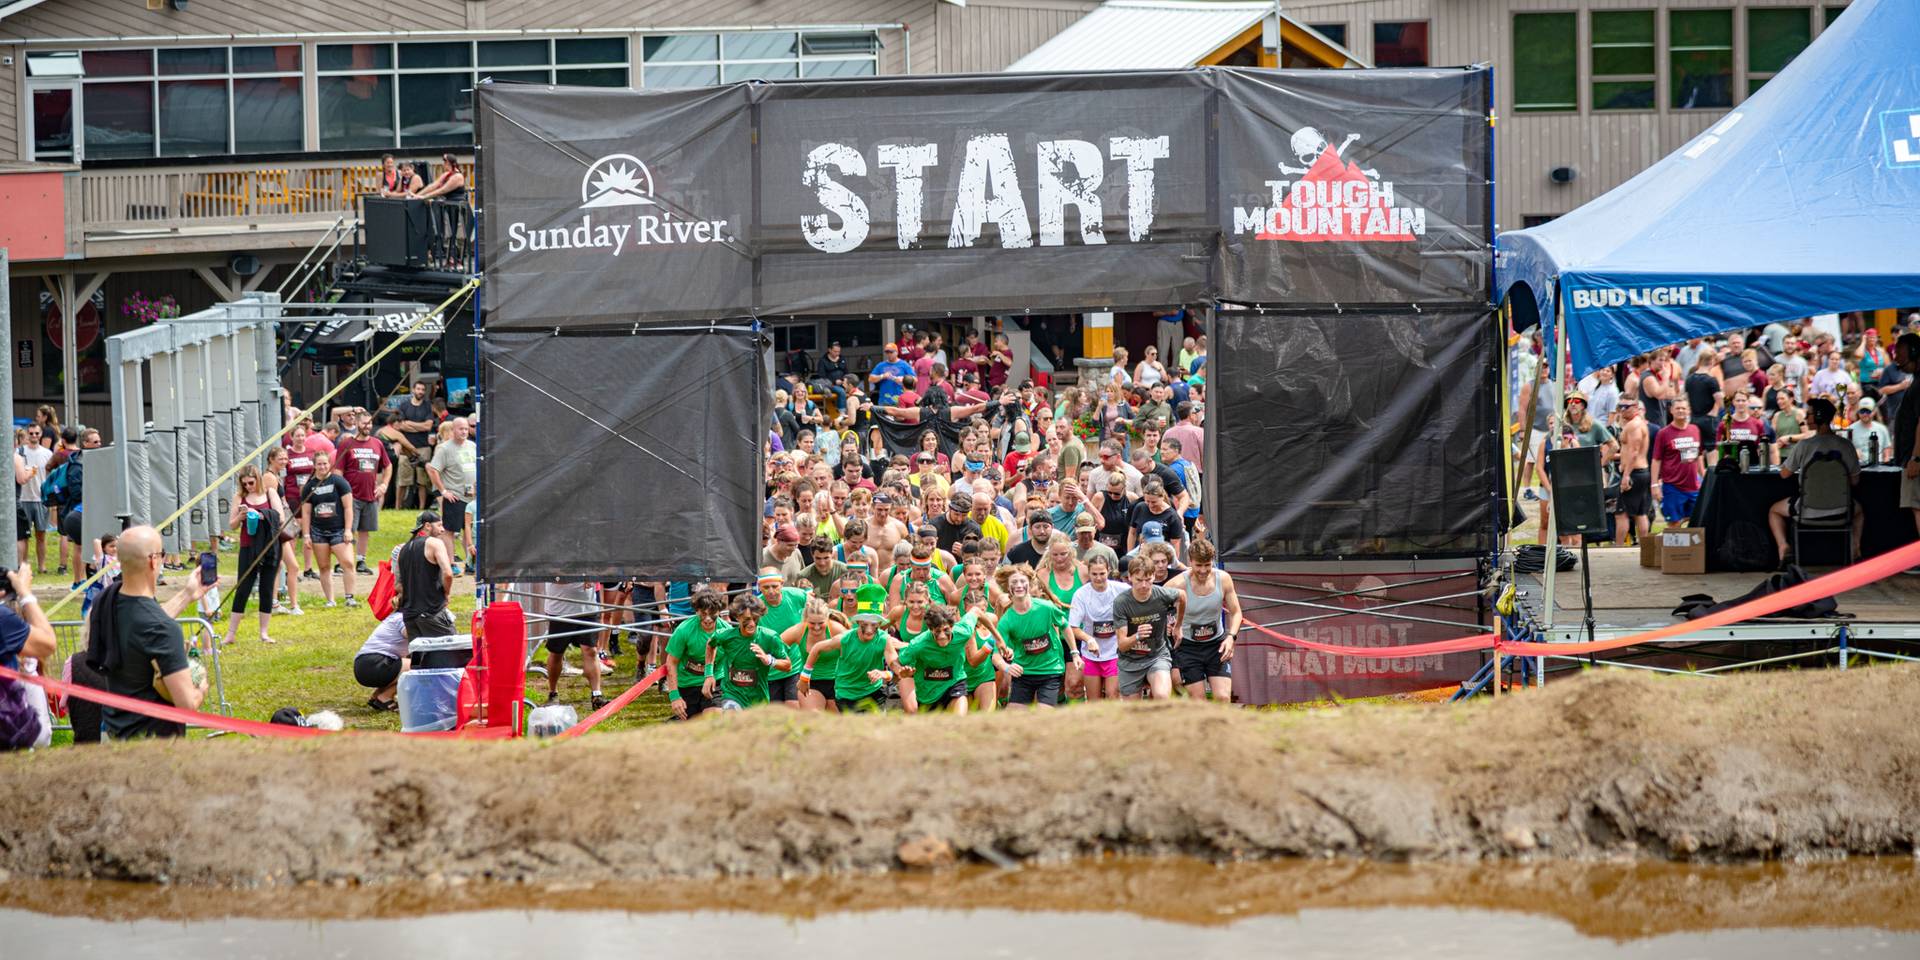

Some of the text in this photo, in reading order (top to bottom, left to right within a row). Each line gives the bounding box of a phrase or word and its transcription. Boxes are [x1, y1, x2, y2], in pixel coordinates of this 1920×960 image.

[801, 132, 1170, 254] START
[1265, 181, 1395, 208] TOUGH
[1234, 206, 1426, 236] MOUNTAIN
[508, 222, 631, 257] Sunday
[1572, 286, 1704, 309] BUD LIGHT
